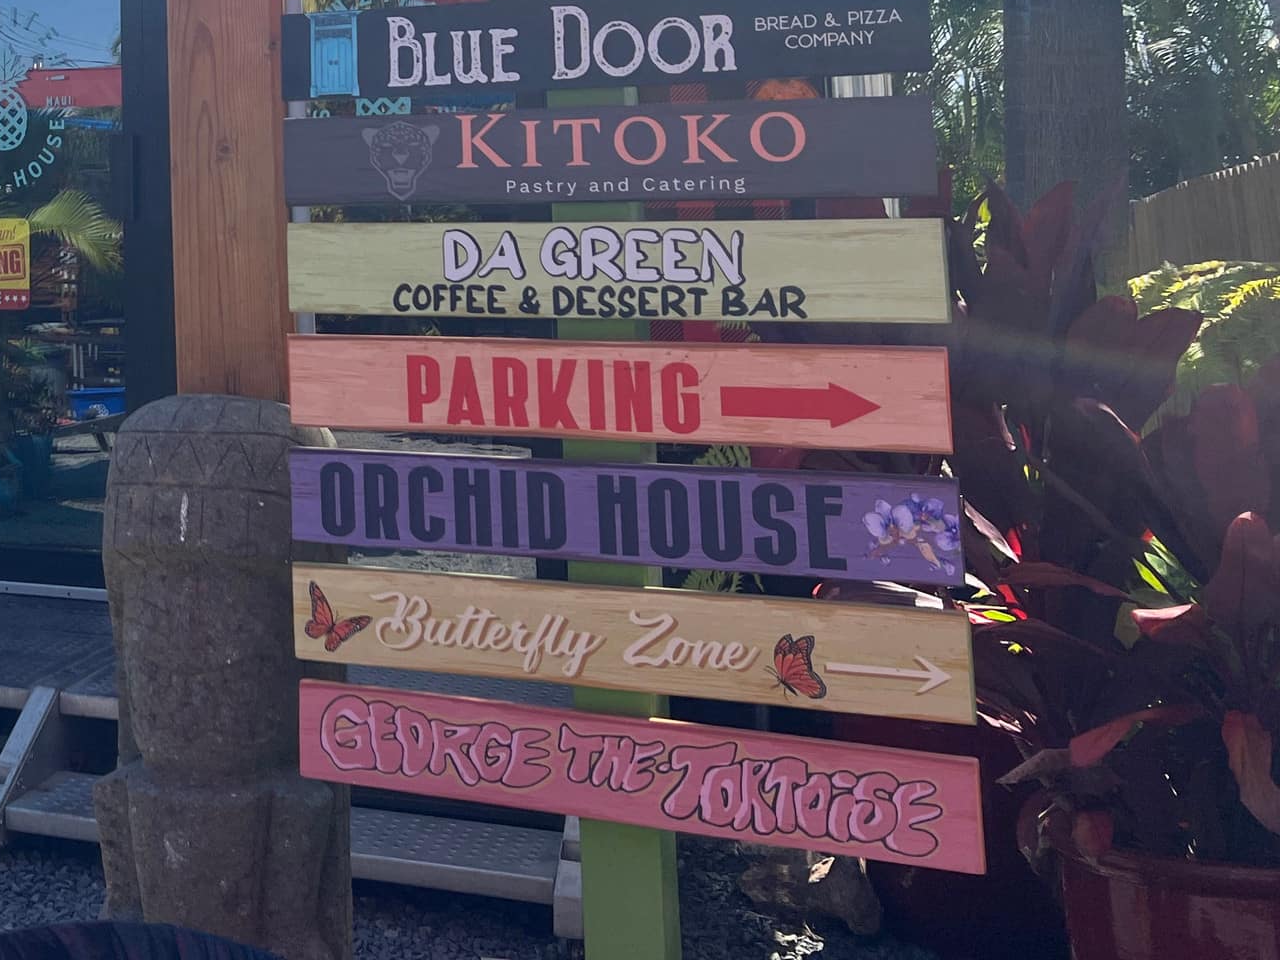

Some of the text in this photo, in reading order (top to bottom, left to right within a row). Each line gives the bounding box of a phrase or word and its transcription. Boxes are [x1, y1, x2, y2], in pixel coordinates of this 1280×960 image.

[386, 5, 738, 88] BLUE DOOR
[754, 8, 903, 32] BREAD & PIZZA
[784, 30, 875, 49] COMPANY
[13, 119, 65, 188] HOUSE
[455, 111, 807, 169] KITOKO
[505, 175, 747, 197] Pastry and Catering
[441, 226, 746, 287] DA GREEN
[392, 283, 809, 319] COFFEE & DESSERT BAR
[405, 353, 702, 435] PARKING
[320, 460, 849, 572] ORCHID HOUSE
[370, 591, 761, 678] Butterfly Zone
[320, 695, 552, 791] GEORGE
